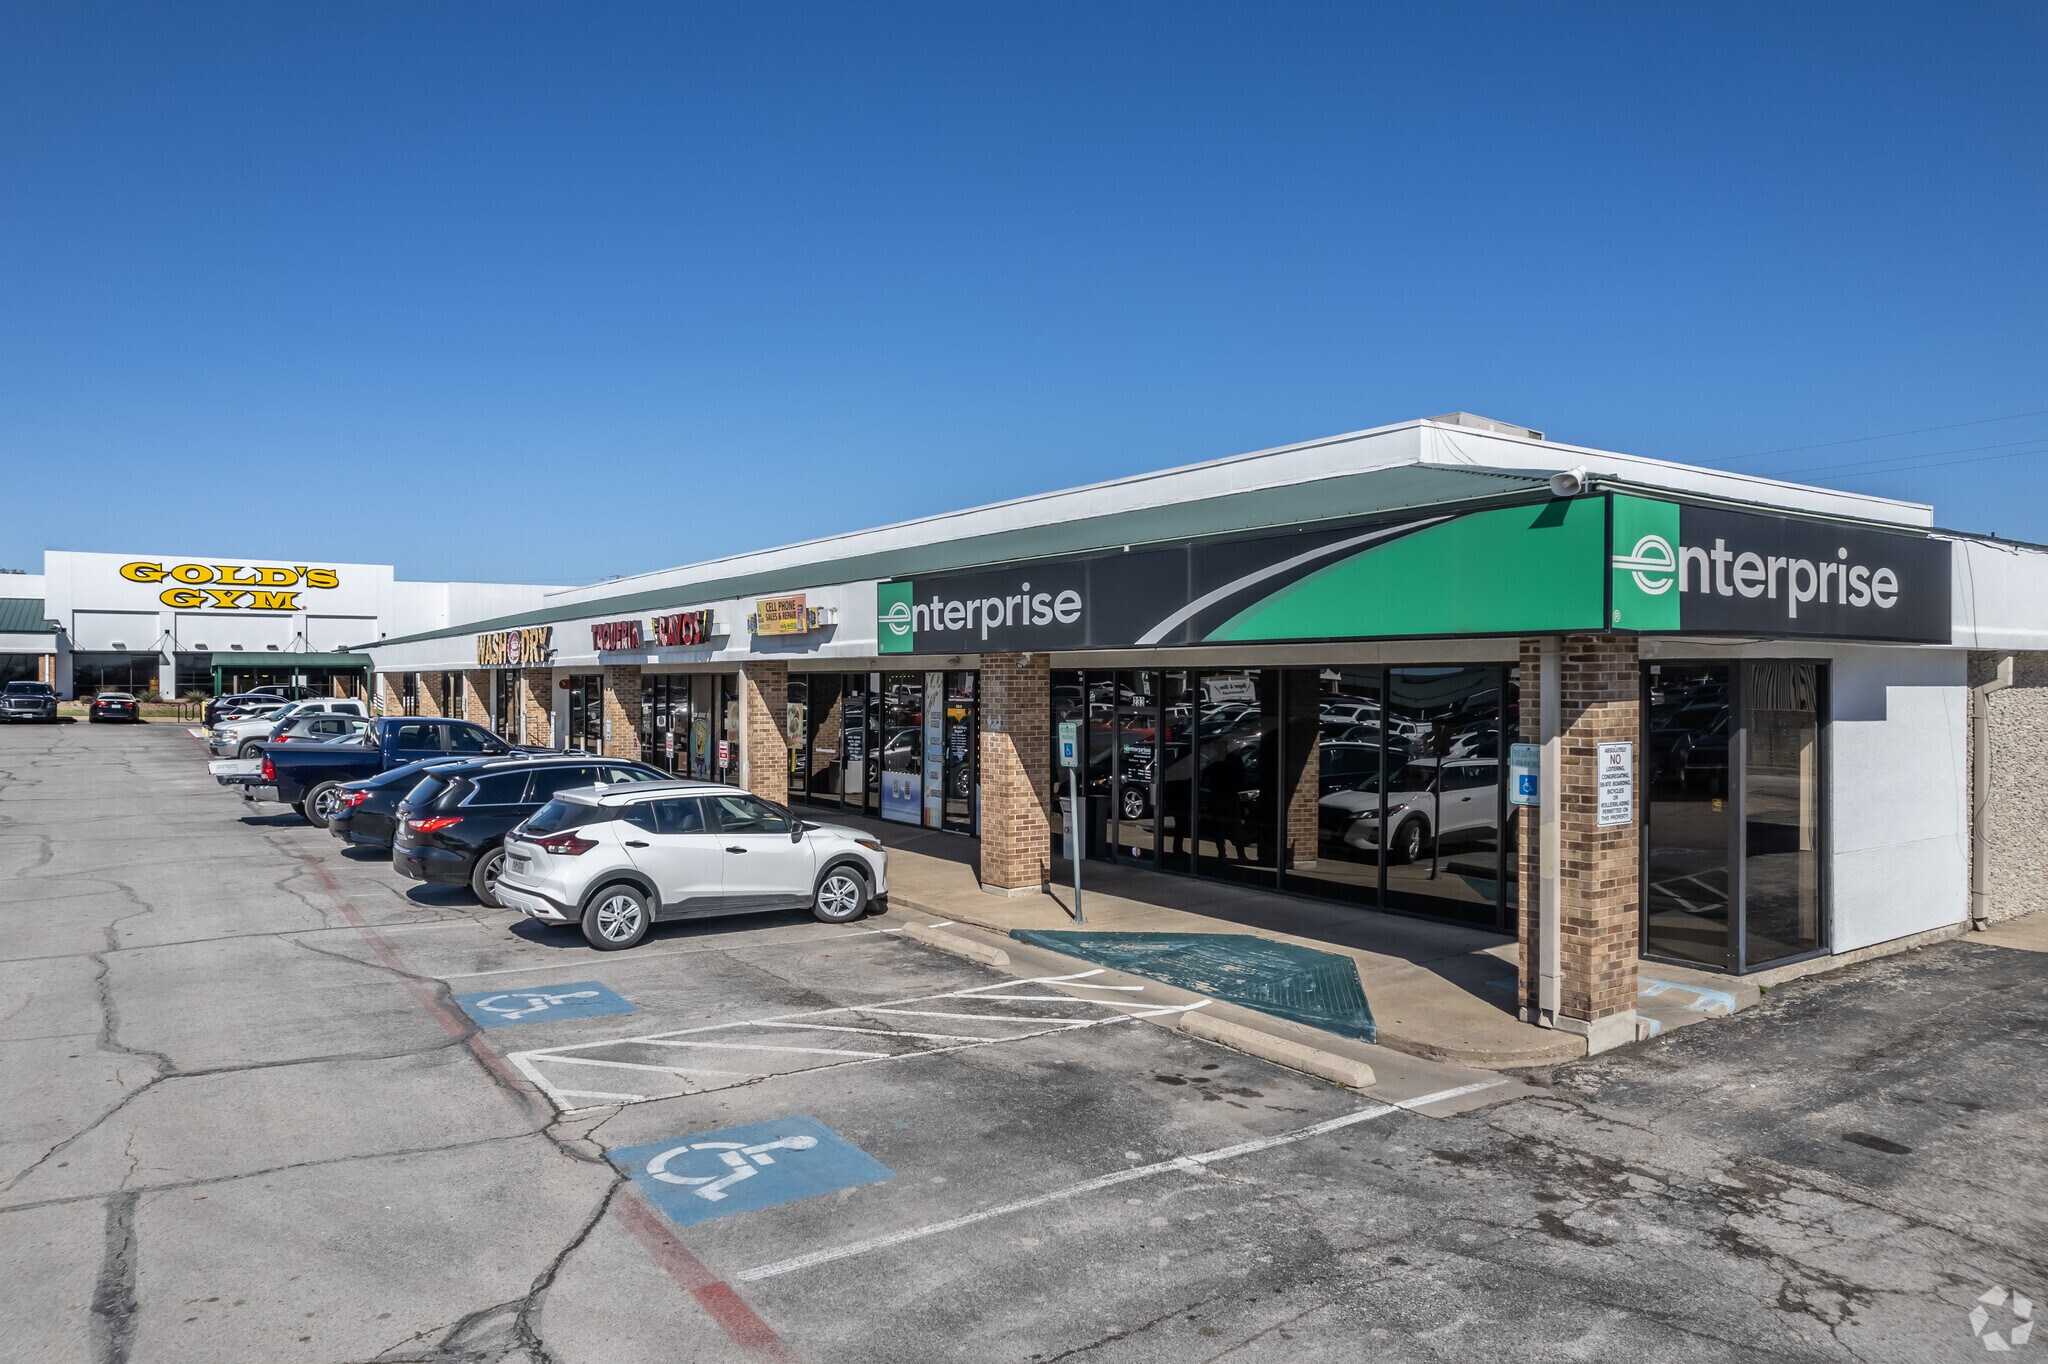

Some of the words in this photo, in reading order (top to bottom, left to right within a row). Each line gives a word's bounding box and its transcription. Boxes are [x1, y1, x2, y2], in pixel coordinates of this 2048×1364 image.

[119, 562, 340, 589] GOLD'S
[1613, 534, 1899, 618] enterprise
[159, 587, 304, 611] GYM
[765, 601, 777, 612] CELL
[778, 600, 795, 611] PHONE
[879, 582, 1083, 640] enterprise
[765, 612, 778, 621] SALES
[782, 611, 796, 620] REPAIR
[591, 620, 640, 651] TAQUERIA
[658, 612, 700, 646] RAYOS
[476, 631, 507, 665] WASH
[520, 626, 548, 663] DRY
[1514, 750, 1540, 758] RESERVE
[1610, 754, 1621, 764] NO
[1601, 800, 1630, 808] ROLLERBLADING
